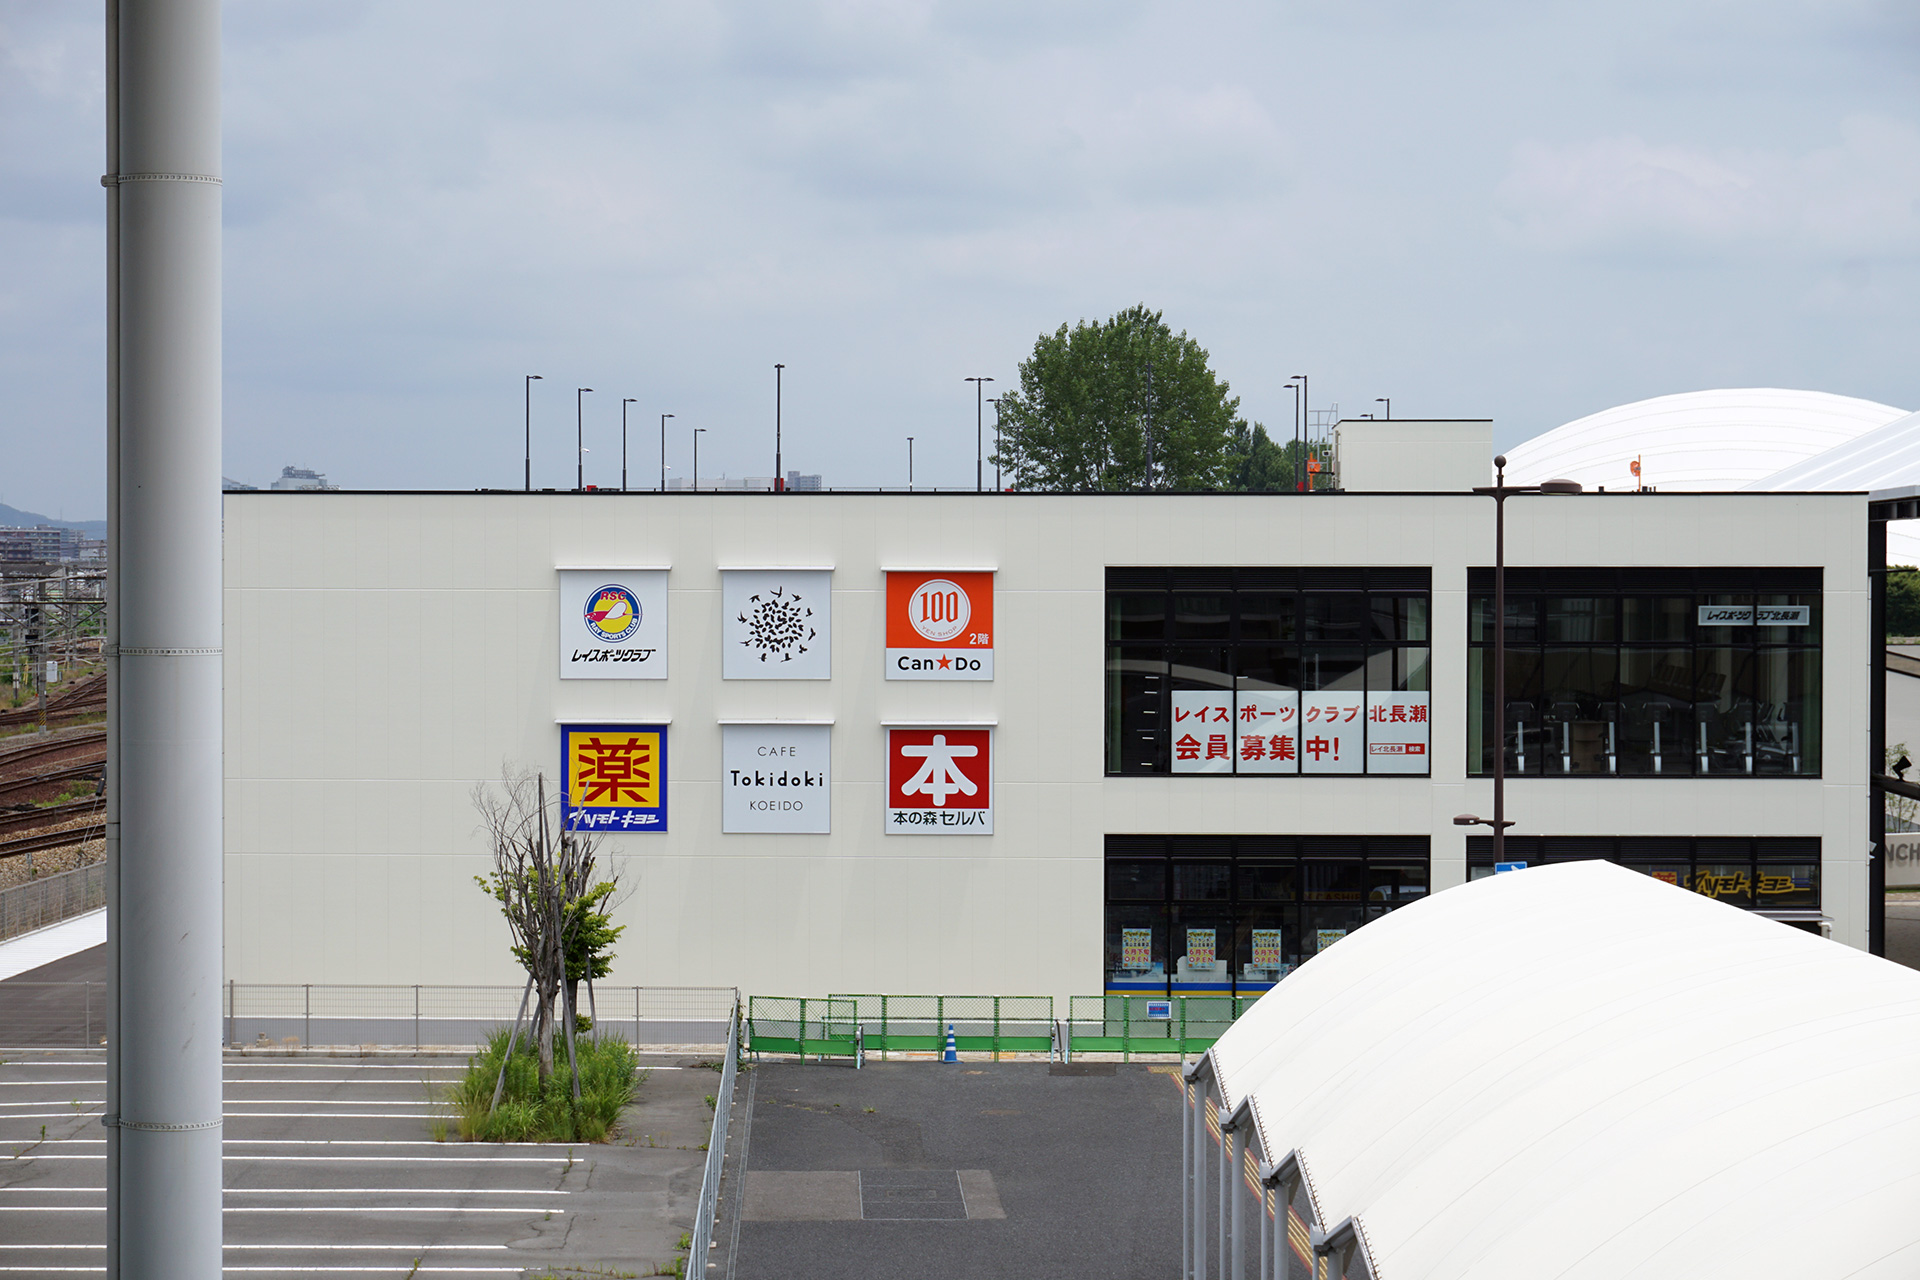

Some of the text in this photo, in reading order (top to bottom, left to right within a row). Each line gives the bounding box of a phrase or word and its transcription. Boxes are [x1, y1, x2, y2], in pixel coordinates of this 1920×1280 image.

[600, 591, 627, 600] RSC
[920, 591, 959, 623] 100
[590, 618, 638, 640] RAY SPORTS CLUB
[922, 625, 957, 636] YEN SHOP
[969, 633, 989, 645] 2階
[571, 649, 657, 662] レイスポーツクラブ
[757, 746, 796, 757] CAFE
[578, 737, 650, 803] 薬
[901, 734, 979, 807] 本
[730, 770, 823, 787] Tokidoki
[749, 800, 804, 811] KOEIDO
[893, 811, 986, 826] 本の森セルバ
